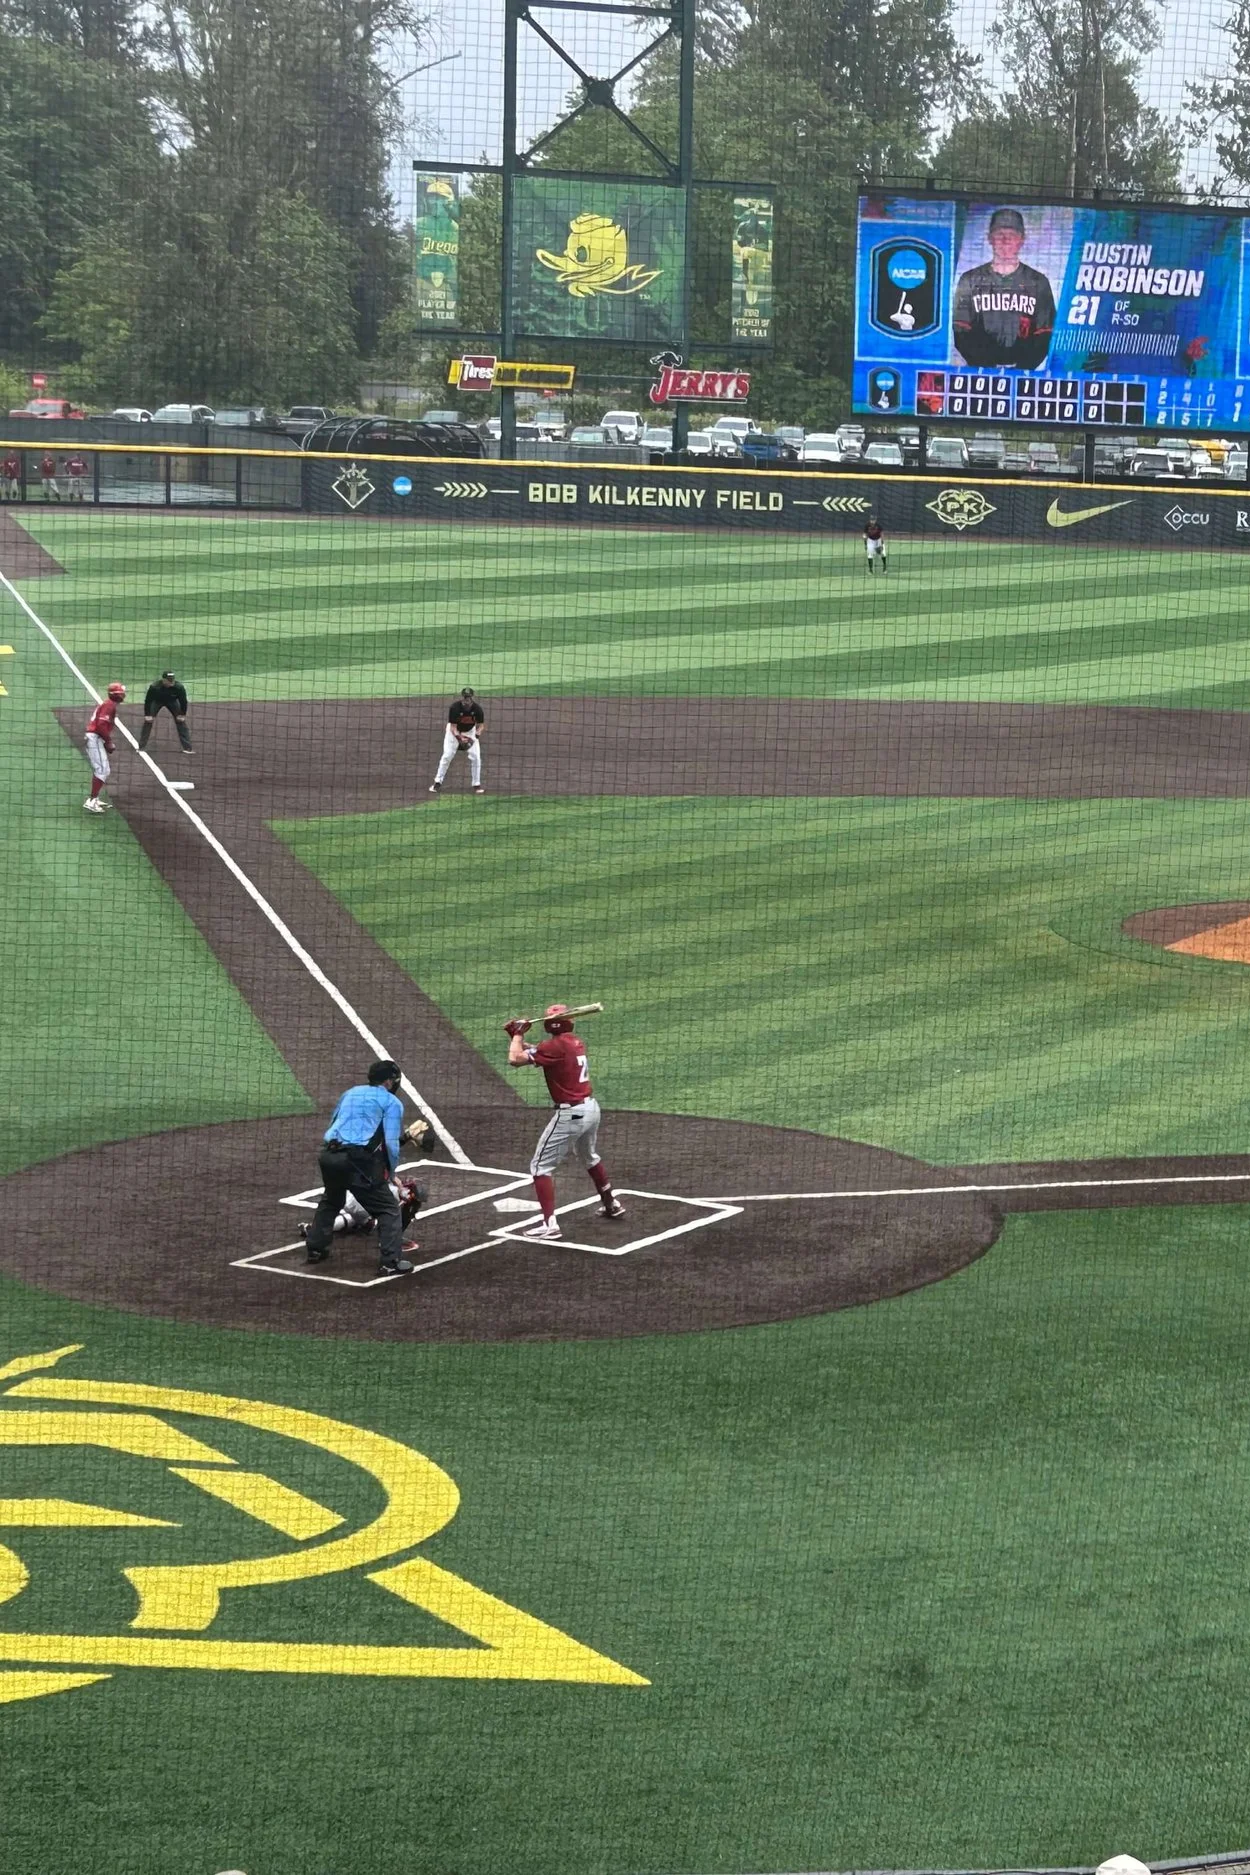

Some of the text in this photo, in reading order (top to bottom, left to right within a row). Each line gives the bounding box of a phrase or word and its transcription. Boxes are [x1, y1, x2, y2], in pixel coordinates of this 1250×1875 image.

[422, 237, 458, 254] Orego
[1081, 242, 1152, 266] DUSTIN
[1075, 264, 1204, 297] ROBINSON
[973, 293, 1037, 315] COUGARS
[1067, 295, 1100, 326] 21
[1114, 300, 1130, 312] OF
[1112, 314, 1139, 326] R-SO
[461, 360, 494, 381] Tires
[650, 365, 751, 404] JERRY'S
[953, 376, 1099, 397] 0 0 0 1 0 1 0
[953, 398, 1098, 419] 0 1 0 0 1 0 0
[1158, 391, 1167, 405] 2
[1207, 393, 1216, 407] 0
[1181, 412, 1191, 426] 5
[1207, 413, 1213, 428] 1
[1232, 402, 1242, 423] 1
[528, 482, 784, 512] BOB KILKENNY FIELD
[1171, 512, 1210, 526] OCCU
